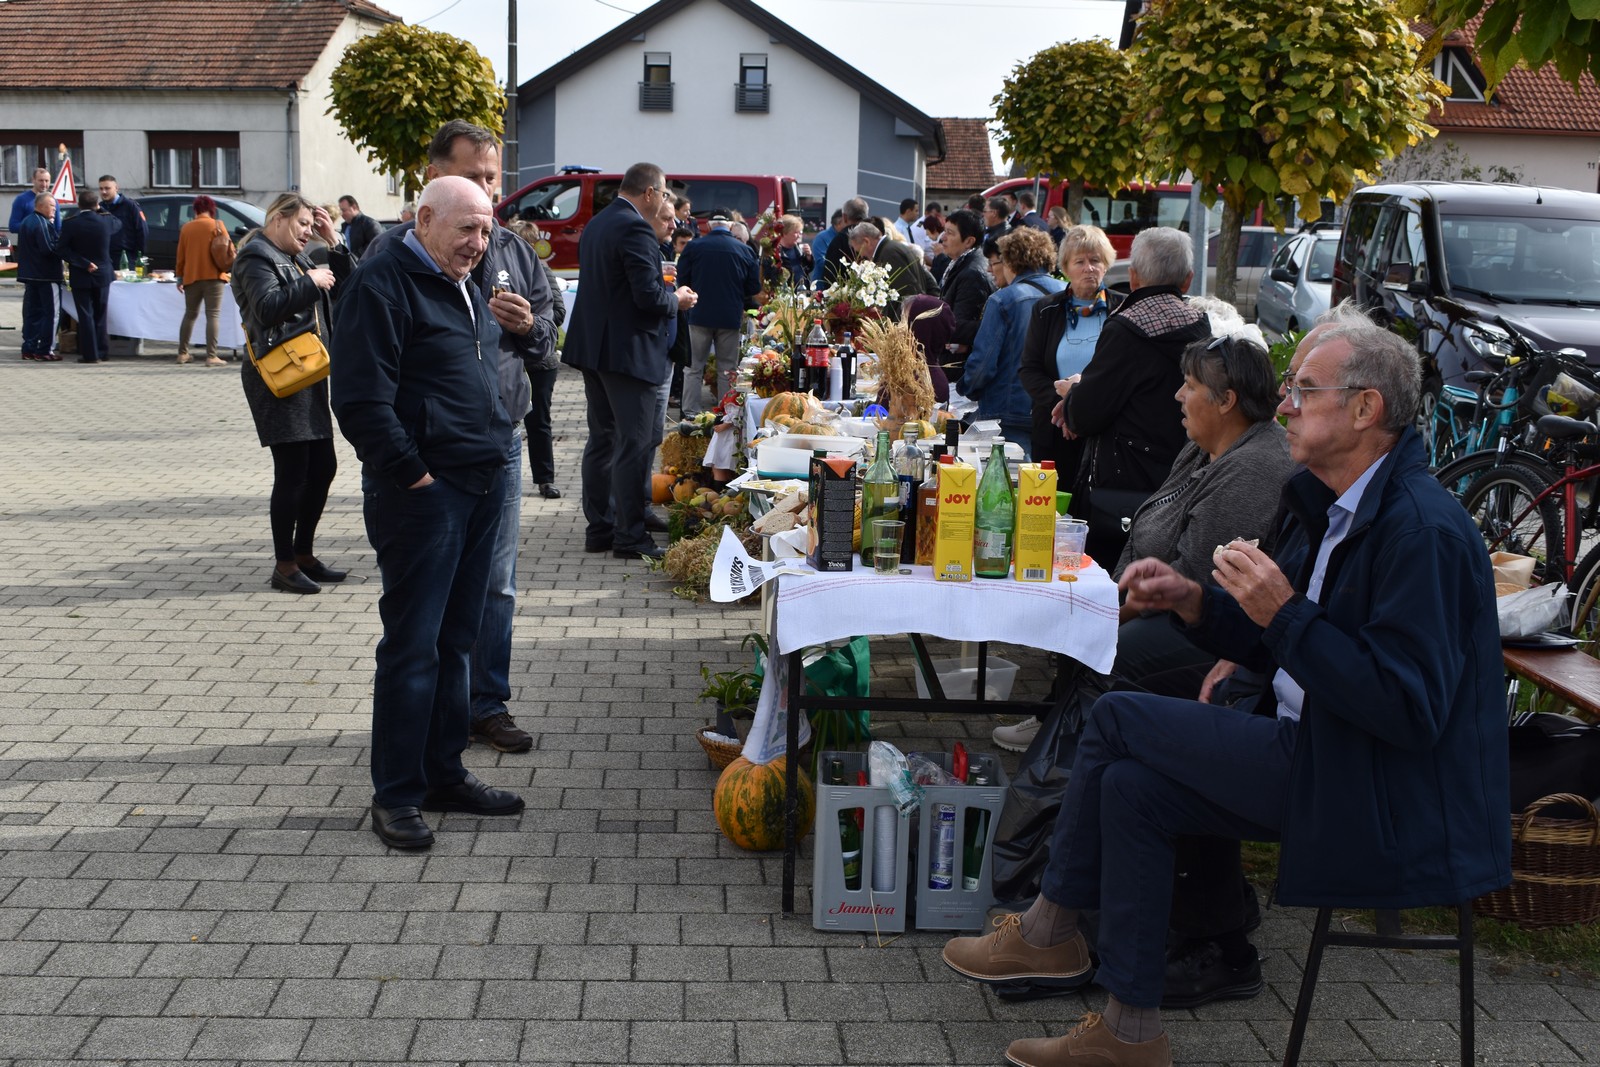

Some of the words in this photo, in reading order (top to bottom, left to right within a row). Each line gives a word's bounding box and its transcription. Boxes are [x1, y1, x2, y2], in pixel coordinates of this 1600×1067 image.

[944, 493, 971, 504] JOY
[1025, 496, 1051, 506] JOY
[829, 901, 895, 914] Jamnica
